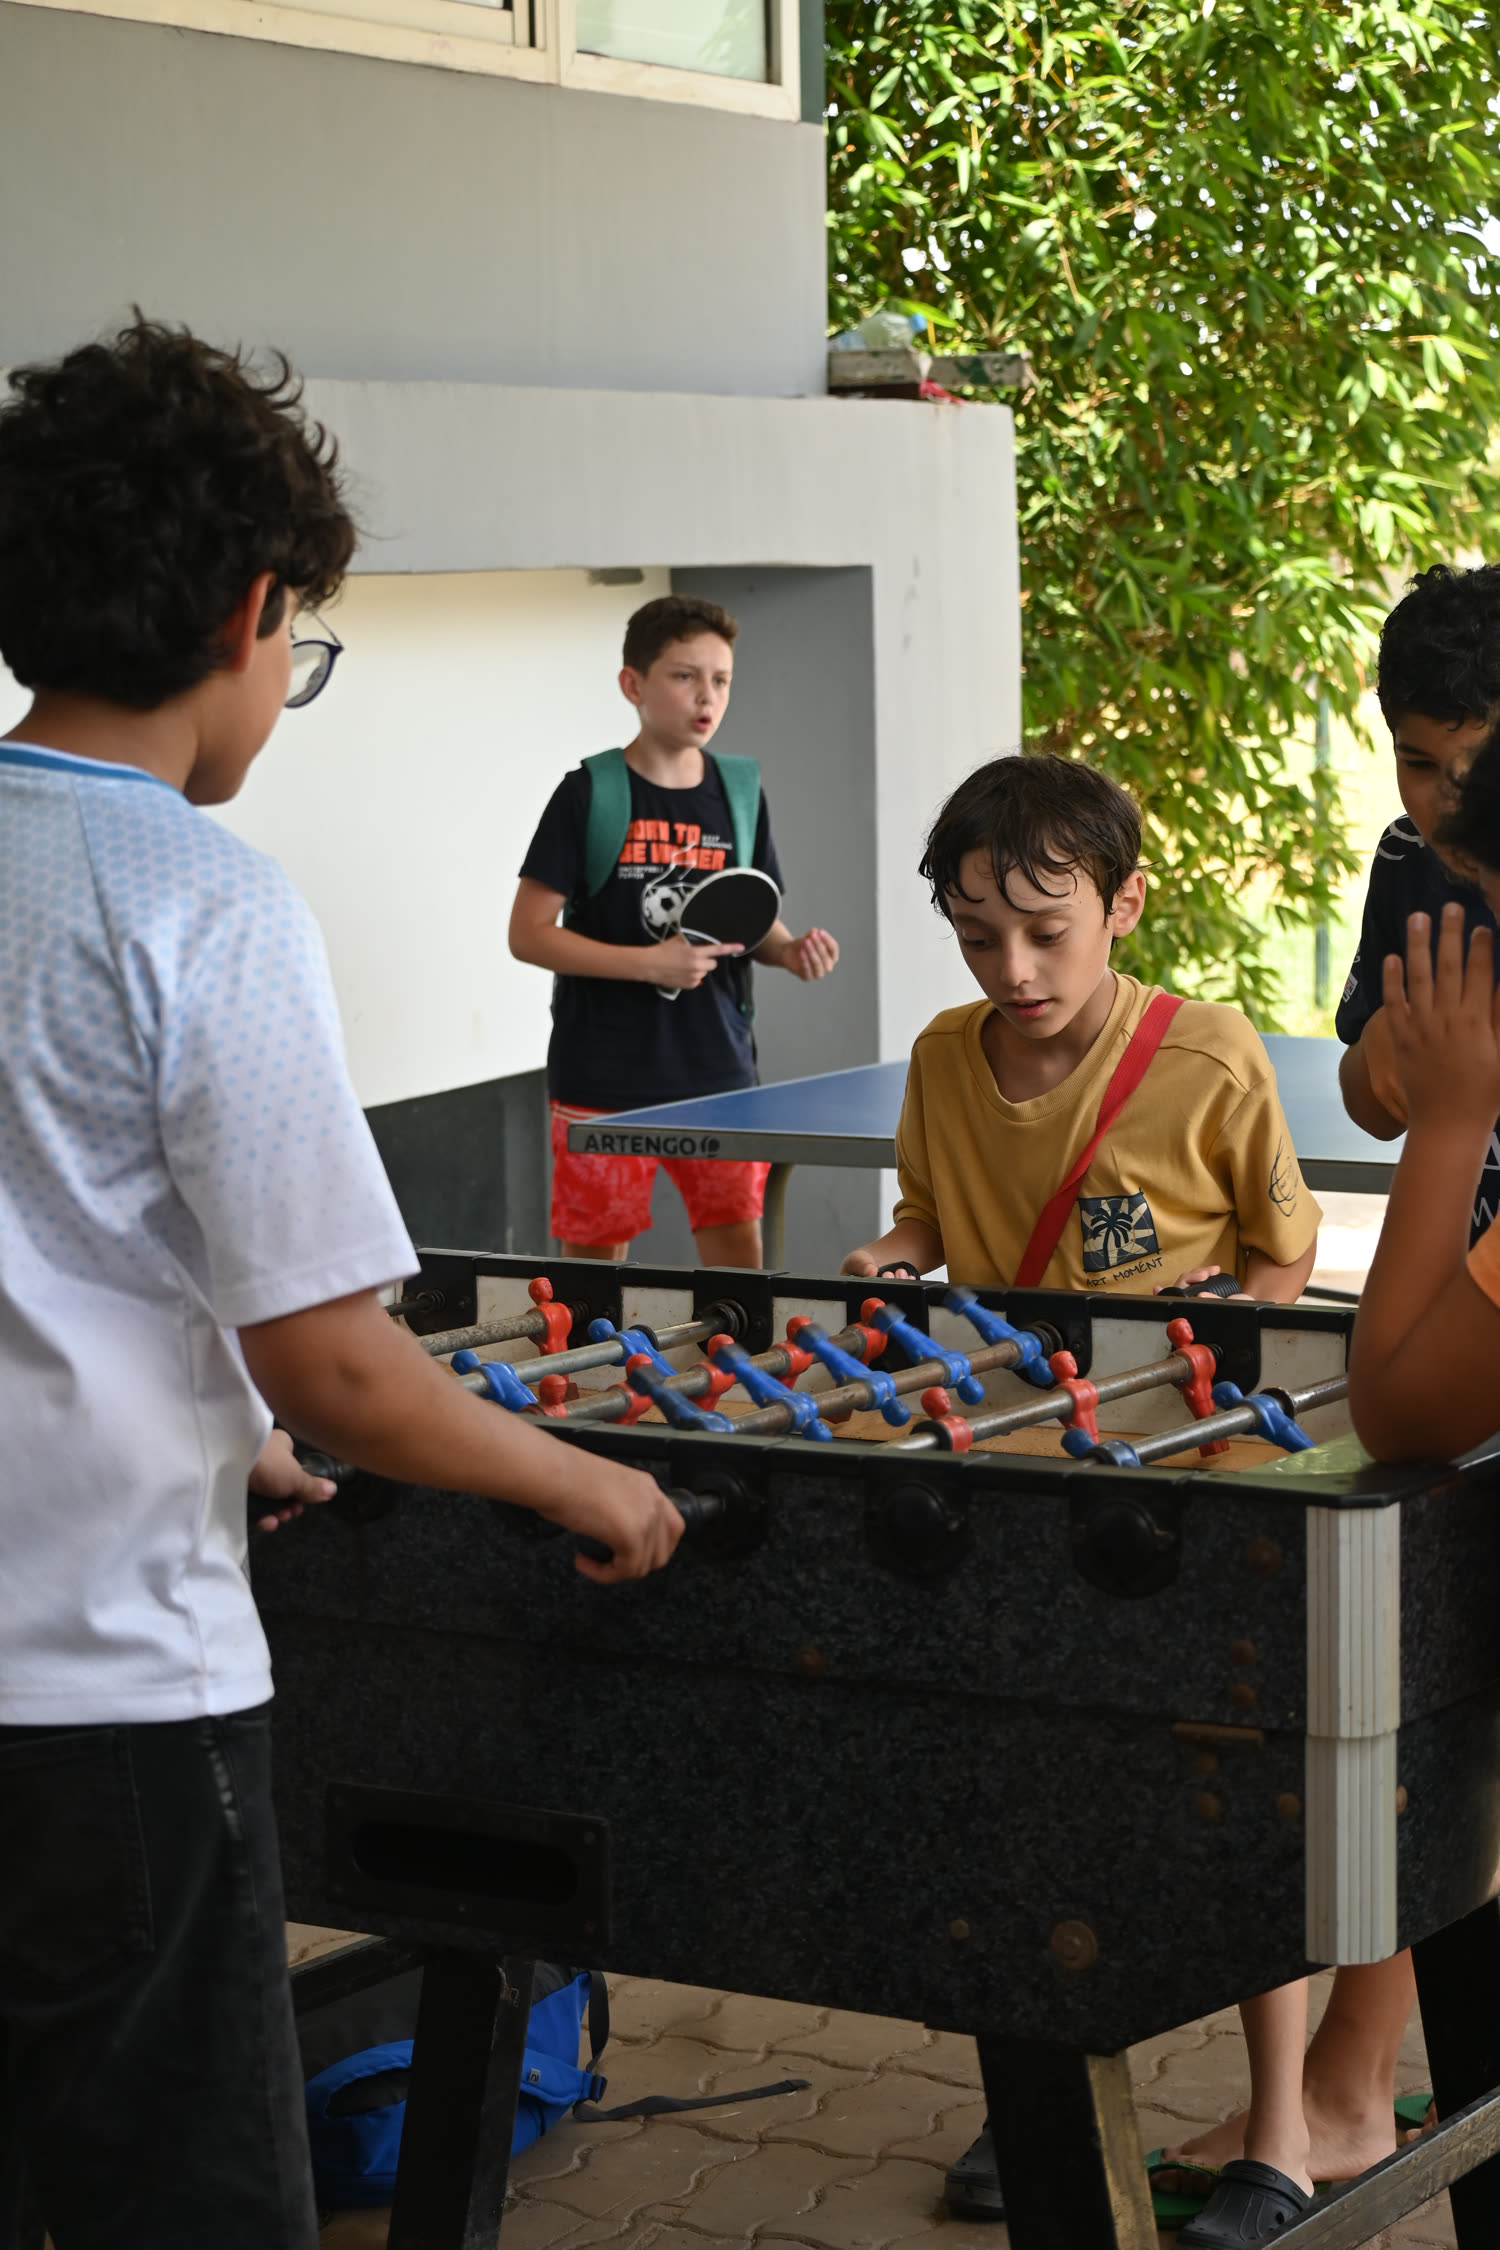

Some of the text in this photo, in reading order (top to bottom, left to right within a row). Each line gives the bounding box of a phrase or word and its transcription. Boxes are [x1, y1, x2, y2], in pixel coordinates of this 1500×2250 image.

[673, 822, 701, 846] TO
[584, 1133, 696, 1155] ARTENGO
[1086, 1257, 1162, 1288] ART MOMENT
